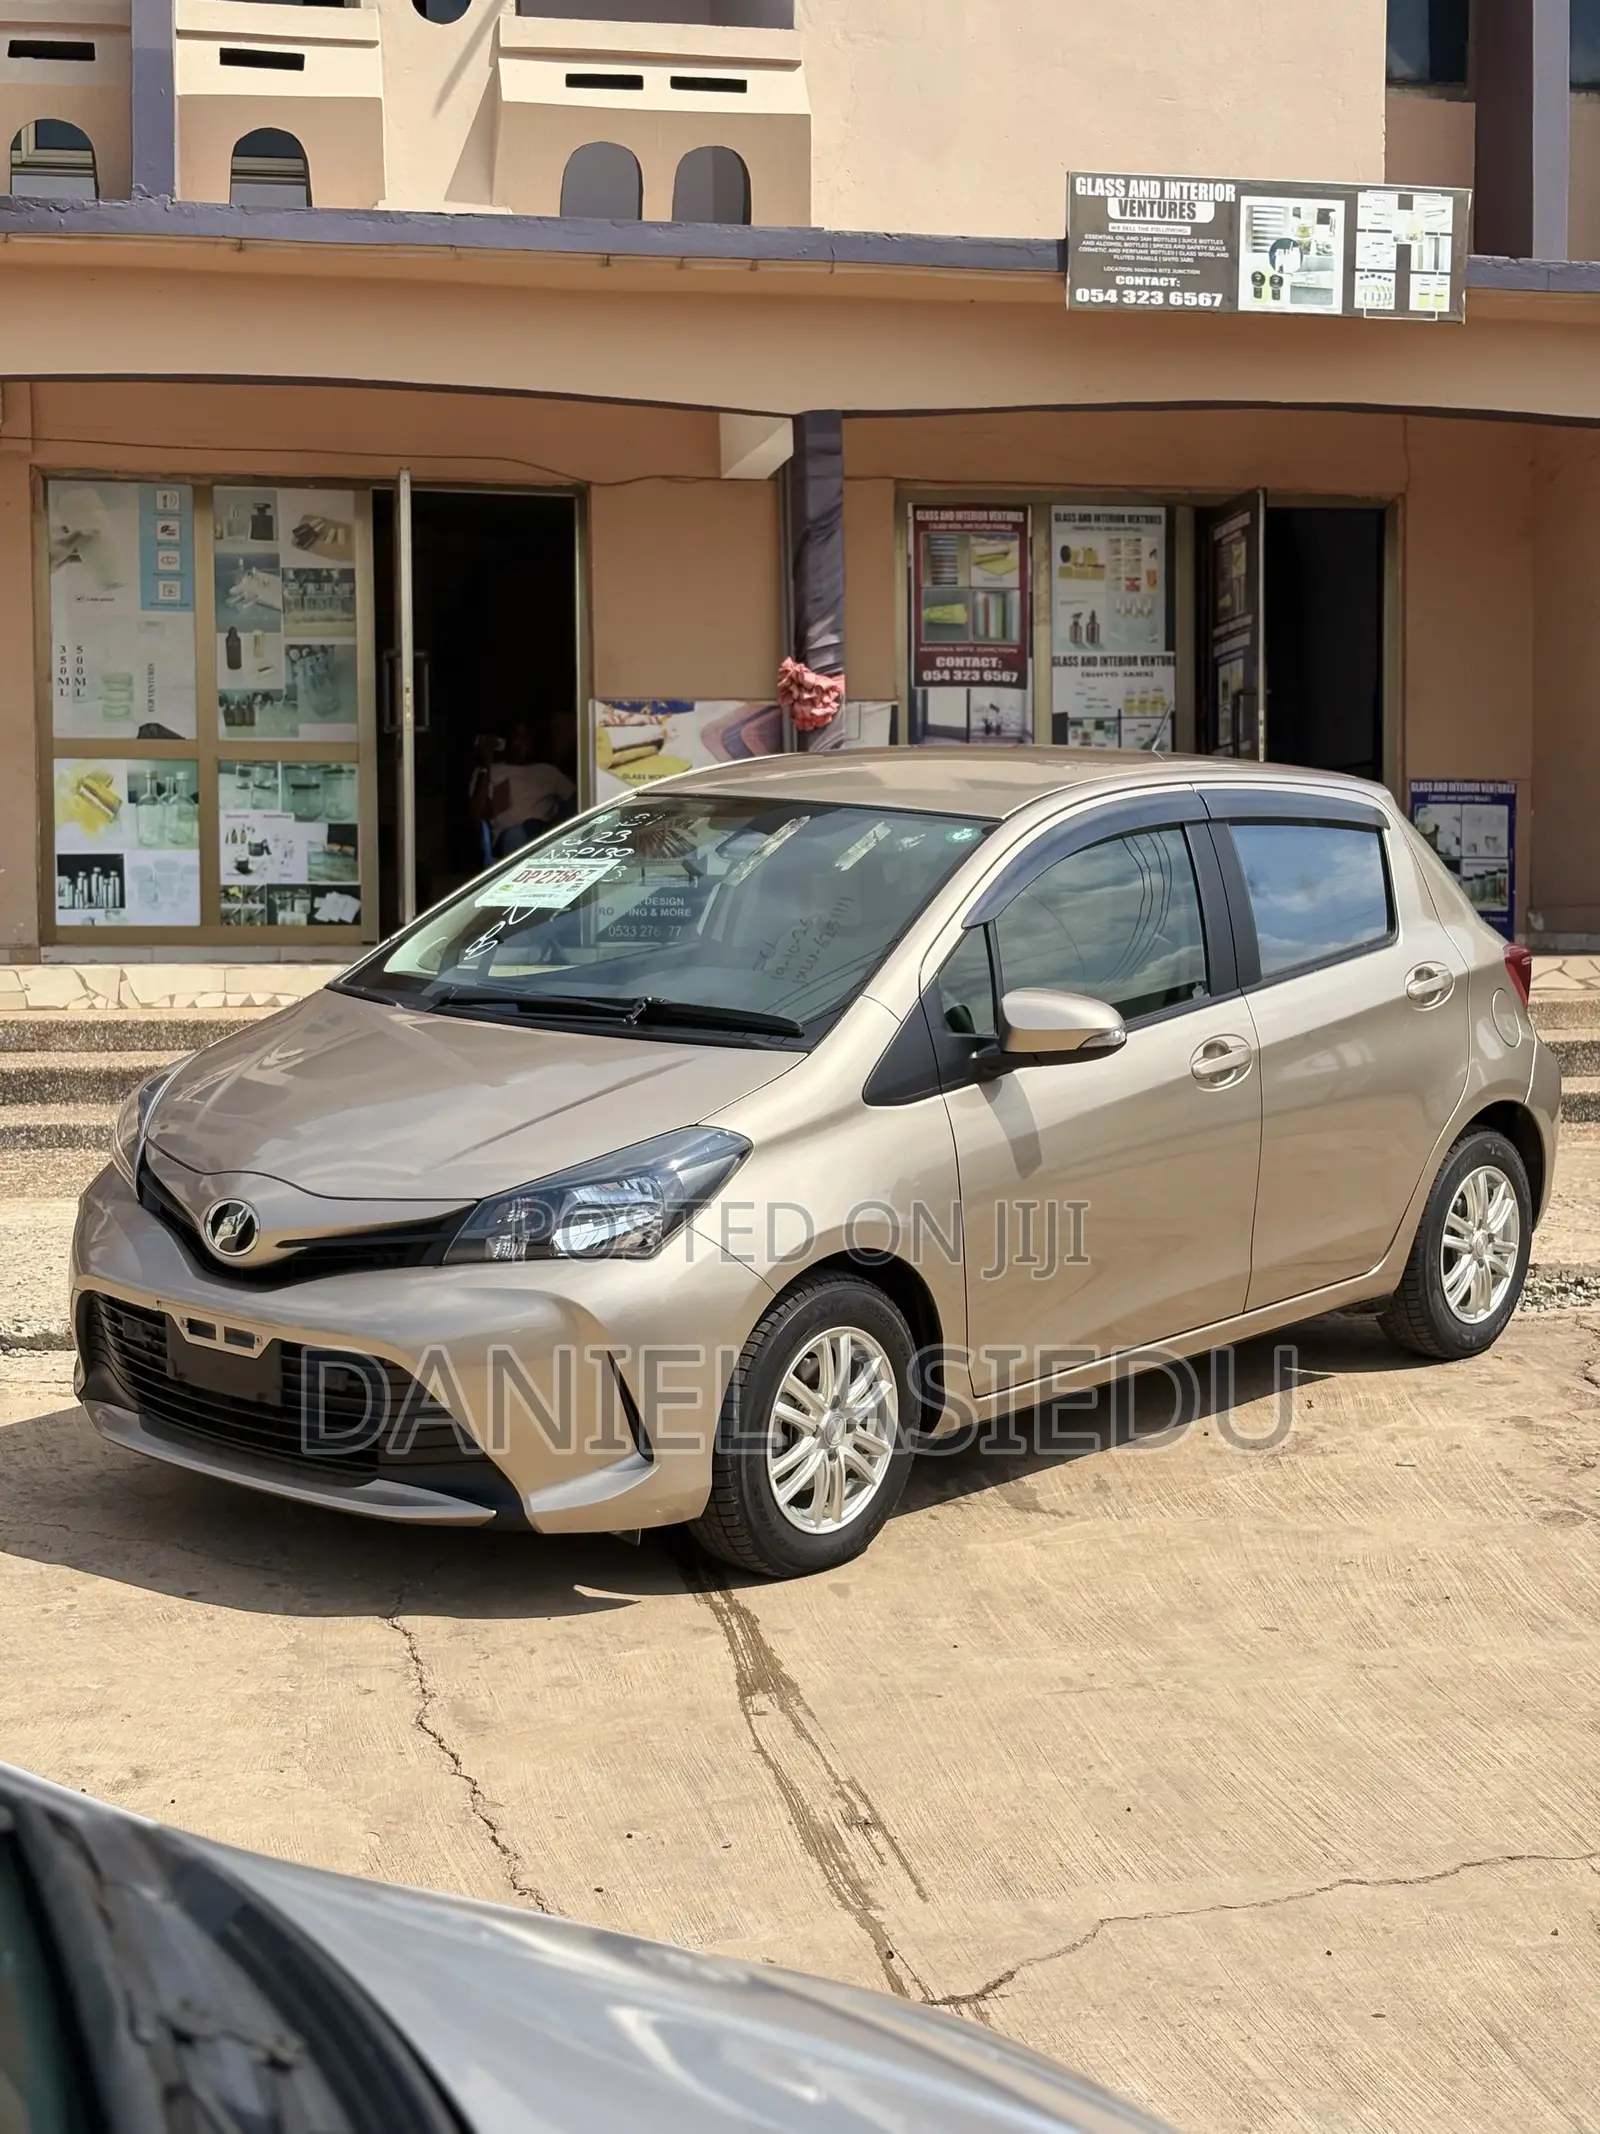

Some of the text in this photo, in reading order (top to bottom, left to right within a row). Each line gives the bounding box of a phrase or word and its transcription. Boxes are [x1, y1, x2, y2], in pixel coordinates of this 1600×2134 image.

[1075, 177, 1236, 202] GLASS AND INTERIOR
[1117, 199, 1197, 220] VENTURES
[1115, 275, 1181, 288] CONTACT:
[1075, 288, 1224, 308] 054 323 6567
[916, 509, 1024, 523] GLASS AND INTERIOR VENTURES
[1054, 512, 1162, 525] GLASS AND INTERIOR VENTURES
[935, 656, 1003, 668] CONTACT:
[1052, 655, 1079, 667] GLASS
[1081, 655, 1098, 667] AND
[1099, 655, 1138, 667] INTERIOR
[922, 669, 1019, 683] 054 323 6567
[1411, 781, 1516, 794] GLASS AND INTERIOR VENTURES
[512, 869, 542, 884] DP
[534, 869, 585, 884] 2756
[644, 897, 685, 906] DESIGN
[650, 908, 658, 917] &
[660, 908, 692, 917] MORE
[608, 925, 637, 937] 0533
[639, 925, 661, 937] 276
